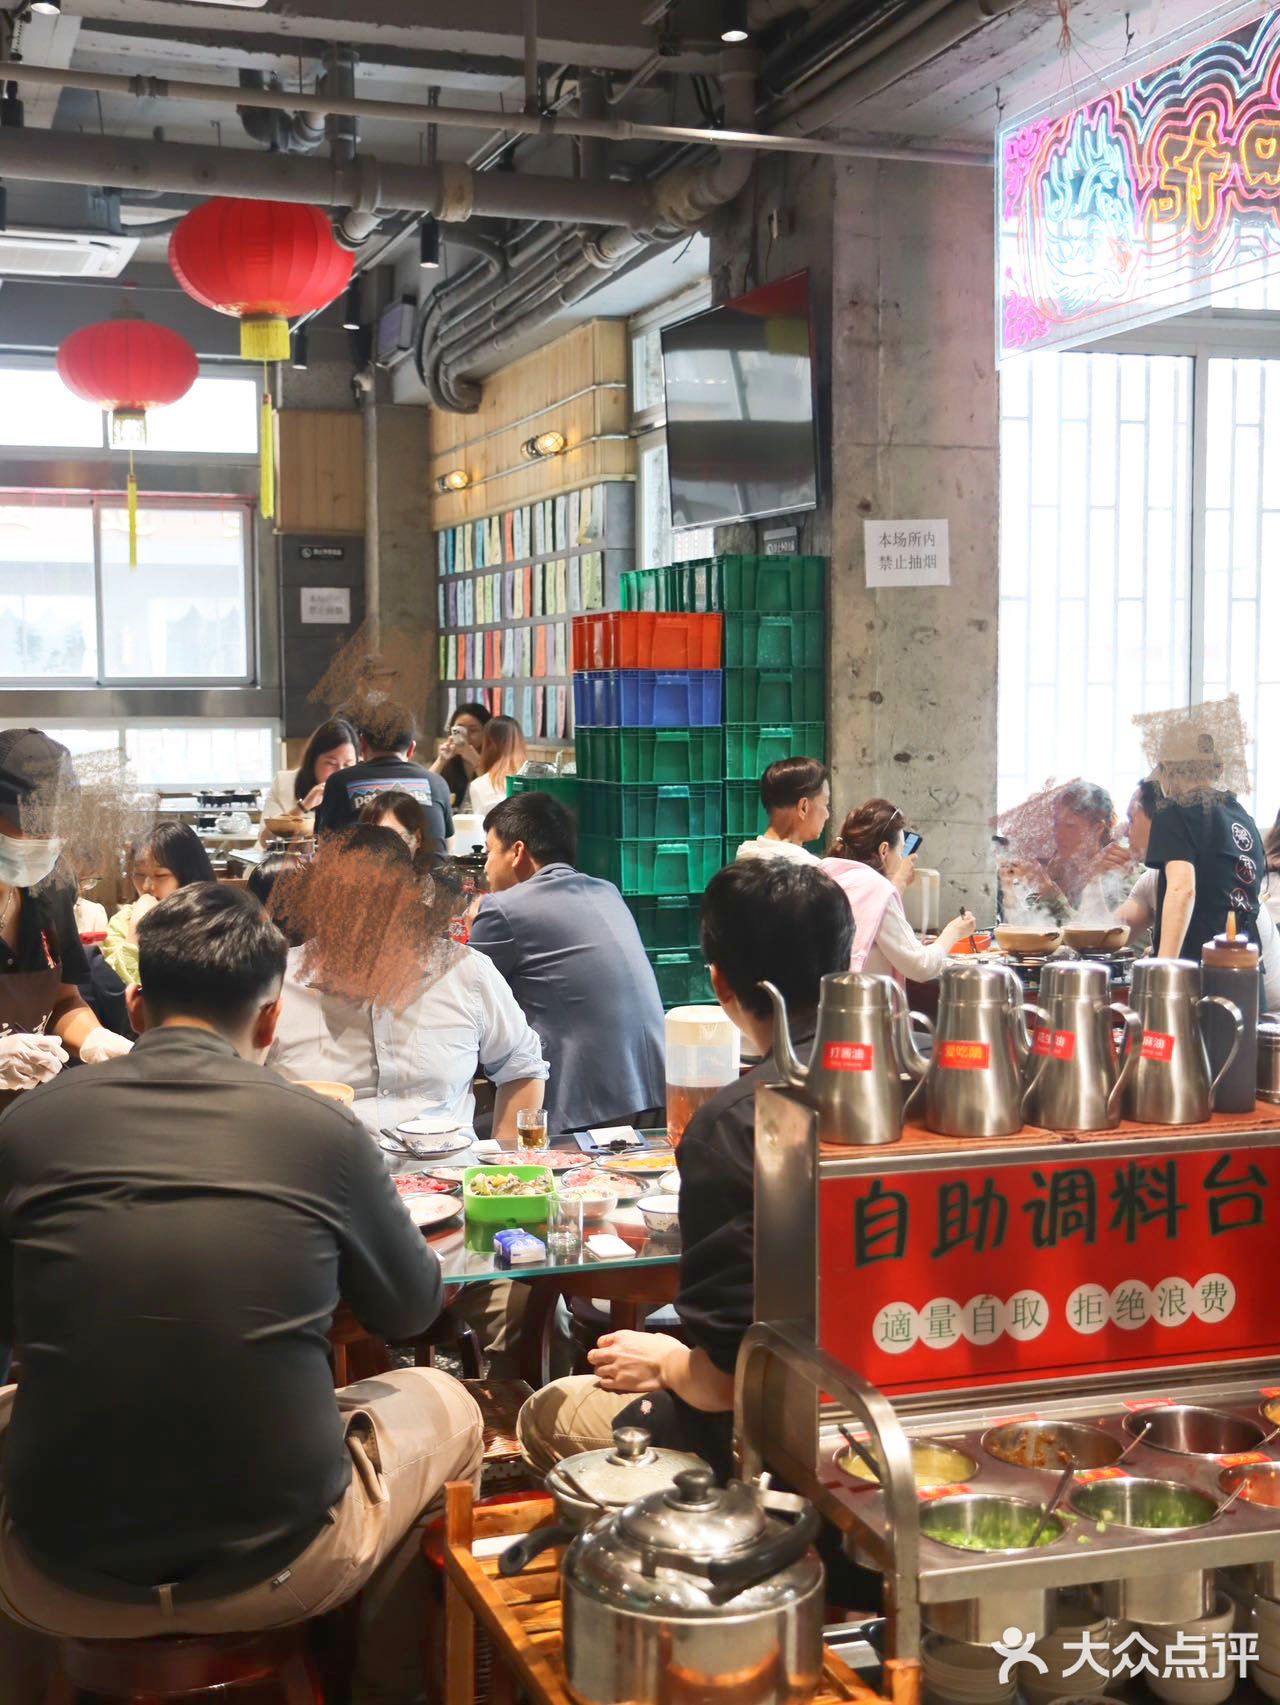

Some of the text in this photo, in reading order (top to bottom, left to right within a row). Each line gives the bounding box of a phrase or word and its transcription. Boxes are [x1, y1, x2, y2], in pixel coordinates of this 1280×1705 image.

[878, 531, 936, 549] 本场所内
[878, 554, 938, 571] 禁止抽烟
[854, 1153, 1270, 1269] 自助调料台
[1072, 1280, 1229, 1327] 拒绝浪费
